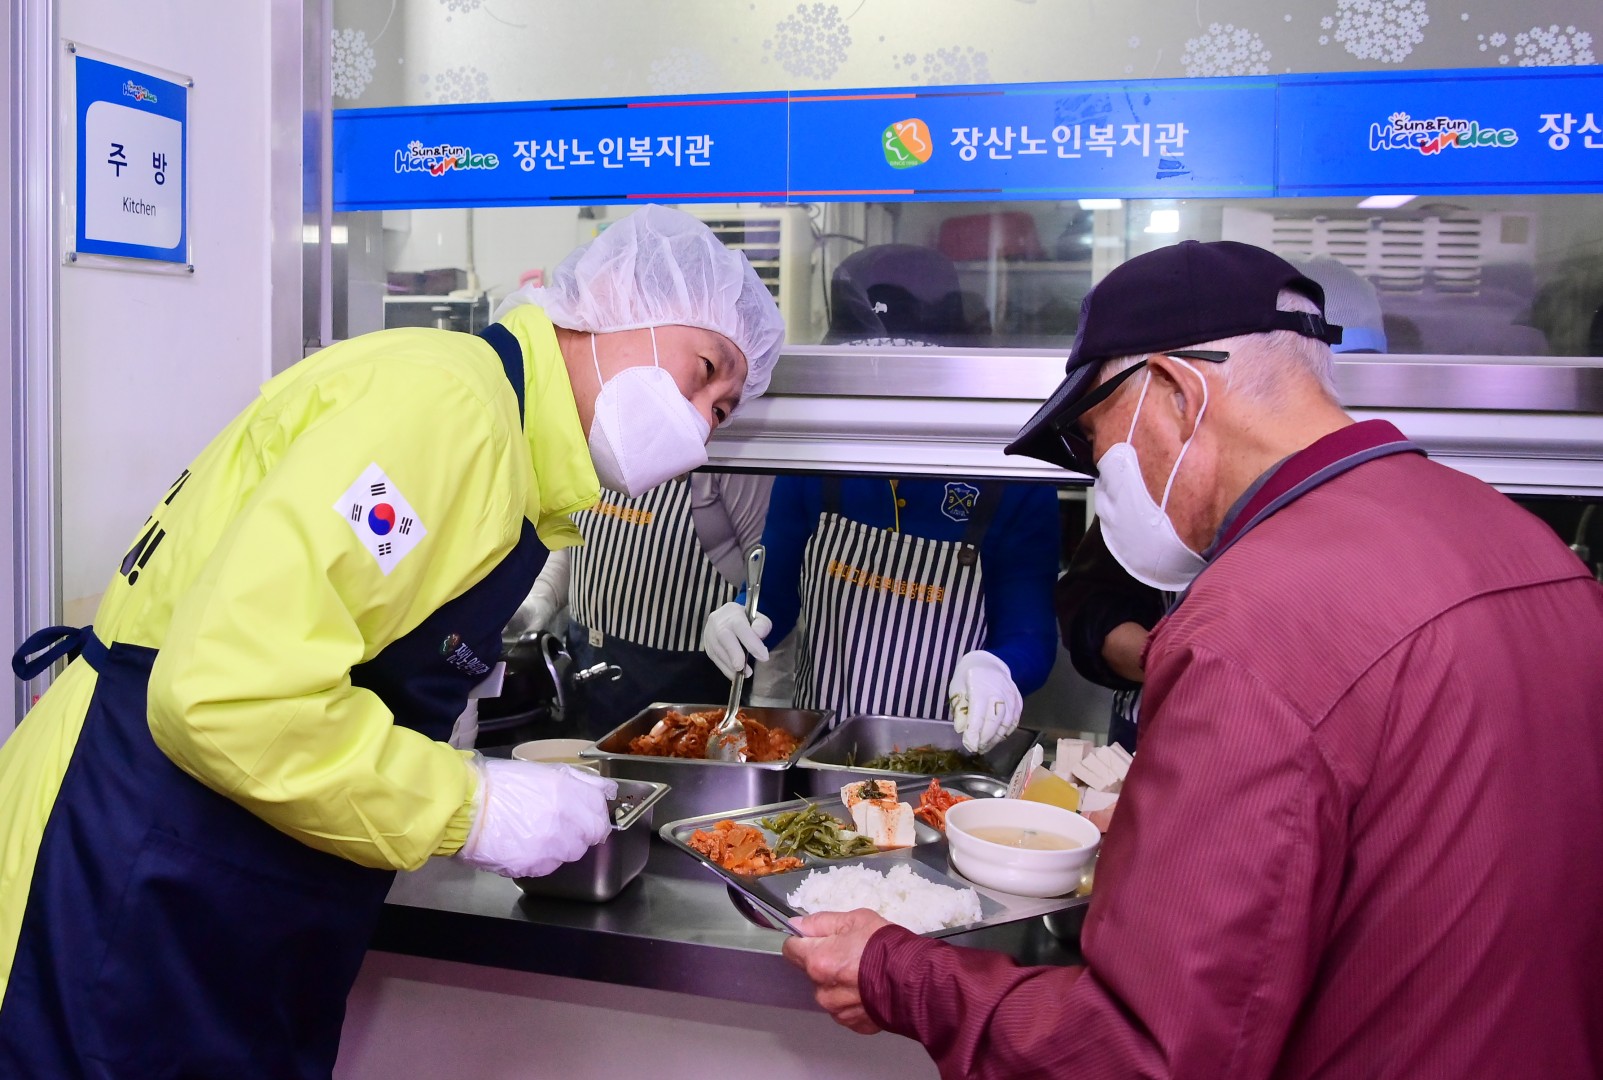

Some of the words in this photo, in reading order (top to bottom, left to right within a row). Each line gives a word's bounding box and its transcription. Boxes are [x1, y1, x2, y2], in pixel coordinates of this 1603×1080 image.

[1369, 121, 1519, 155] Haeundae
[1393, 118, 1468, 132] Sun&Fun
[411, 145, 464, 157] Sun&Fun
[513, 134, 714, 172] 장산노인복지관
[950, 122, 1189, 162] 장산노인복지관
[395, 147, 499, 176] Haeundae
[122, 196, 157, 217] Kitchen
